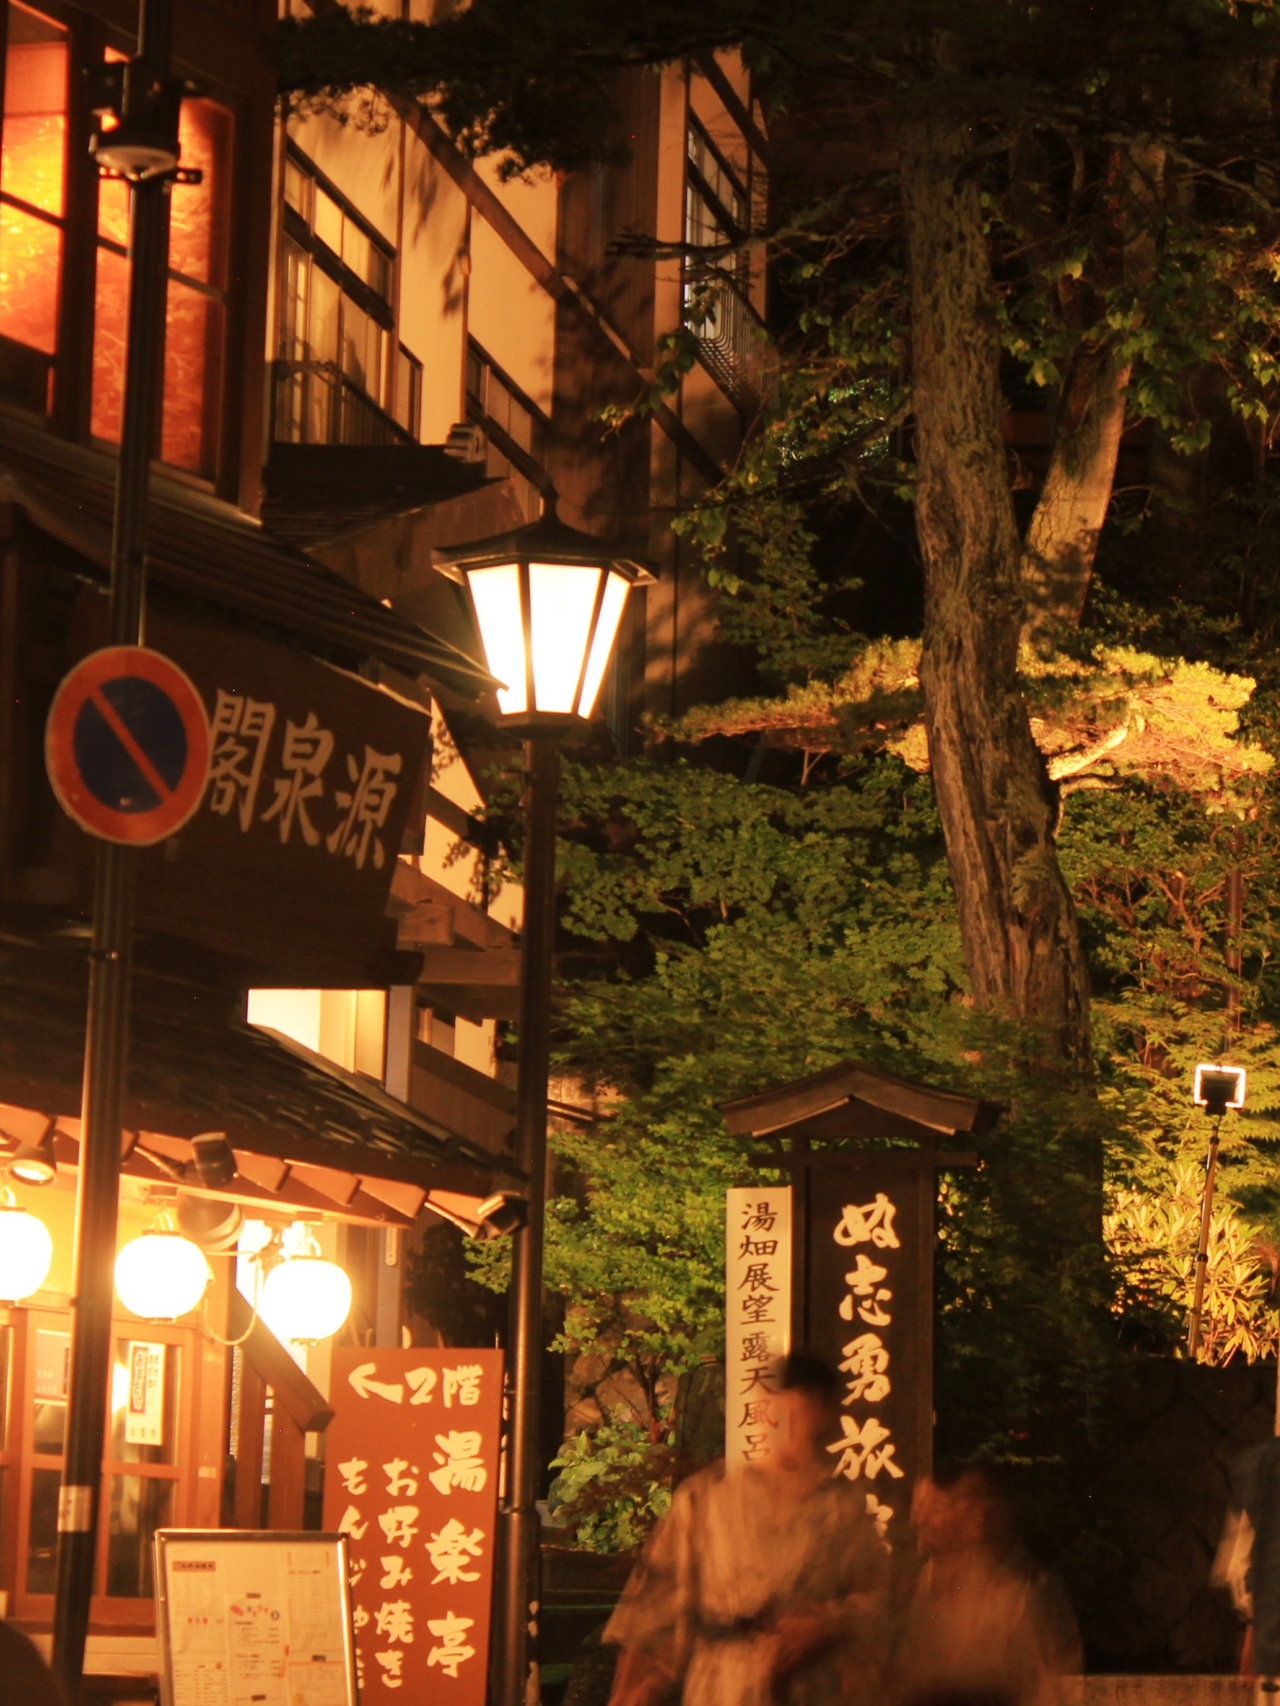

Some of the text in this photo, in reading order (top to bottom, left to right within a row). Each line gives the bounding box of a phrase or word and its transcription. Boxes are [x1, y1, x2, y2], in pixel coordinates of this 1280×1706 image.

[737, 1202, 780, 1461] 湯畑展望露天風呂
[374, 1458, 420, 1689] お好み焼き
[424, 1431, 488, 1678] 湯楽亭
